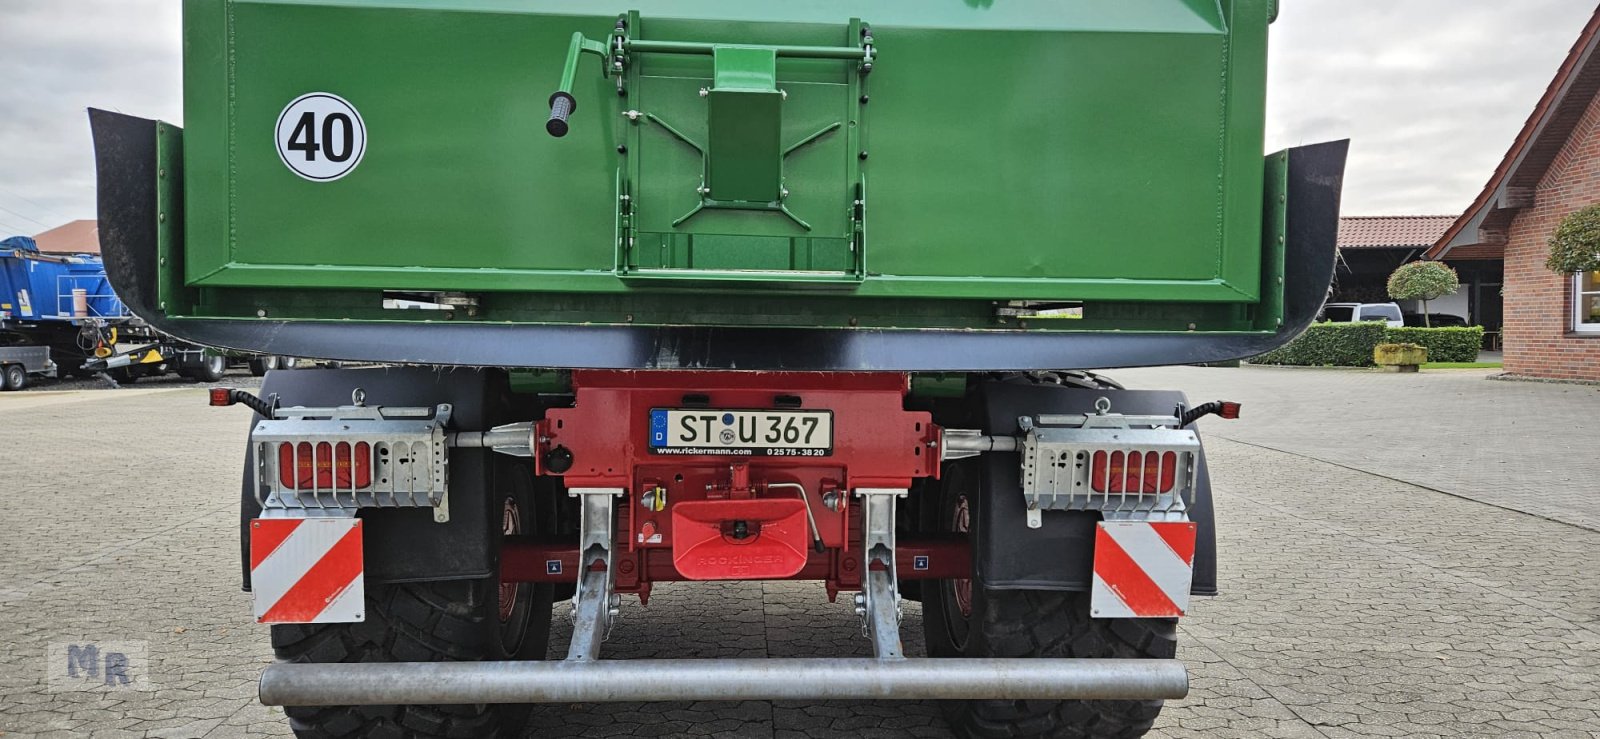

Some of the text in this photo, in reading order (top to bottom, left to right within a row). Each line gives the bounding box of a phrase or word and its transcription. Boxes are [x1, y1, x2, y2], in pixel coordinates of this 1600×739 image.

[288, 112, 353, 162] 40
[656, 432, 663, 440] D
[680, 415, 717, 442] ST
[739, 416, 756, 443] U
[765, 416, 818, 445] 367
